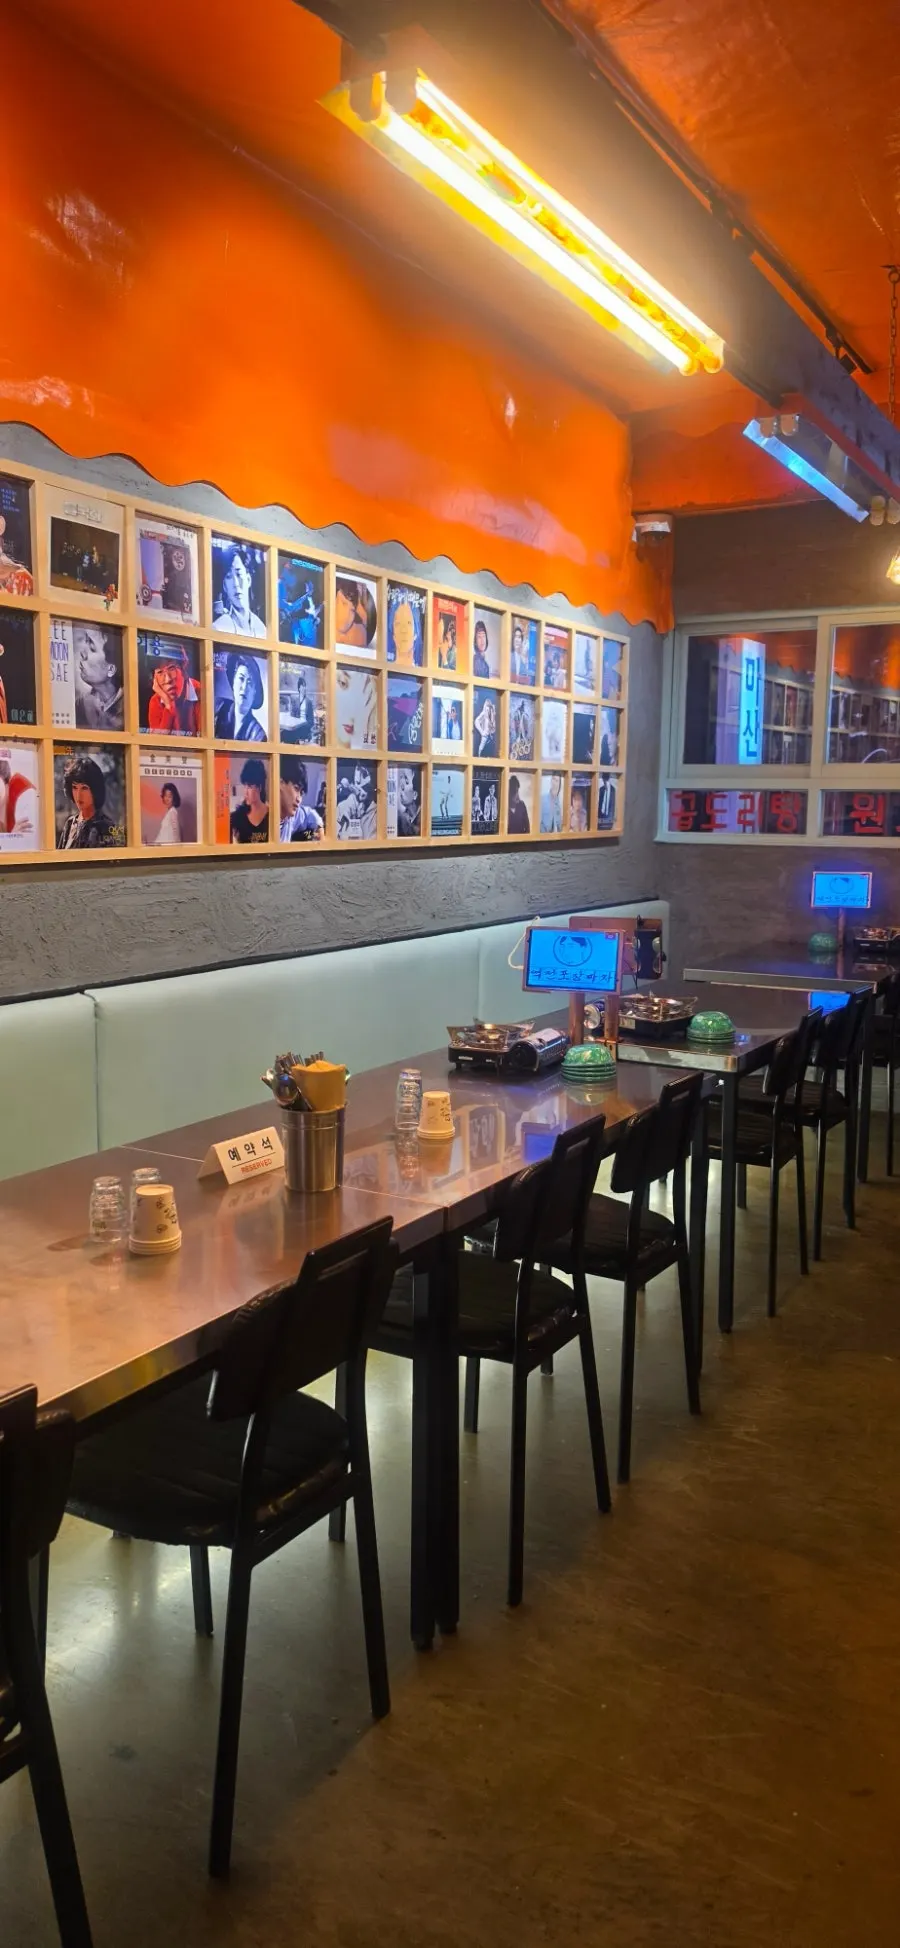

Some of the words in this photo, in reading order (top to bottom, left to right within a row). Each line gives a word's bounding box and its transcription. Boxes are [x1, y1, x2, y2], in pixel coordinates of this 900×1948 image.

[743, 657, 761, 757] 마산
[227, 1136, 274, 1162] 예약석
[240, 1158, 273, 1174] RESERVED
